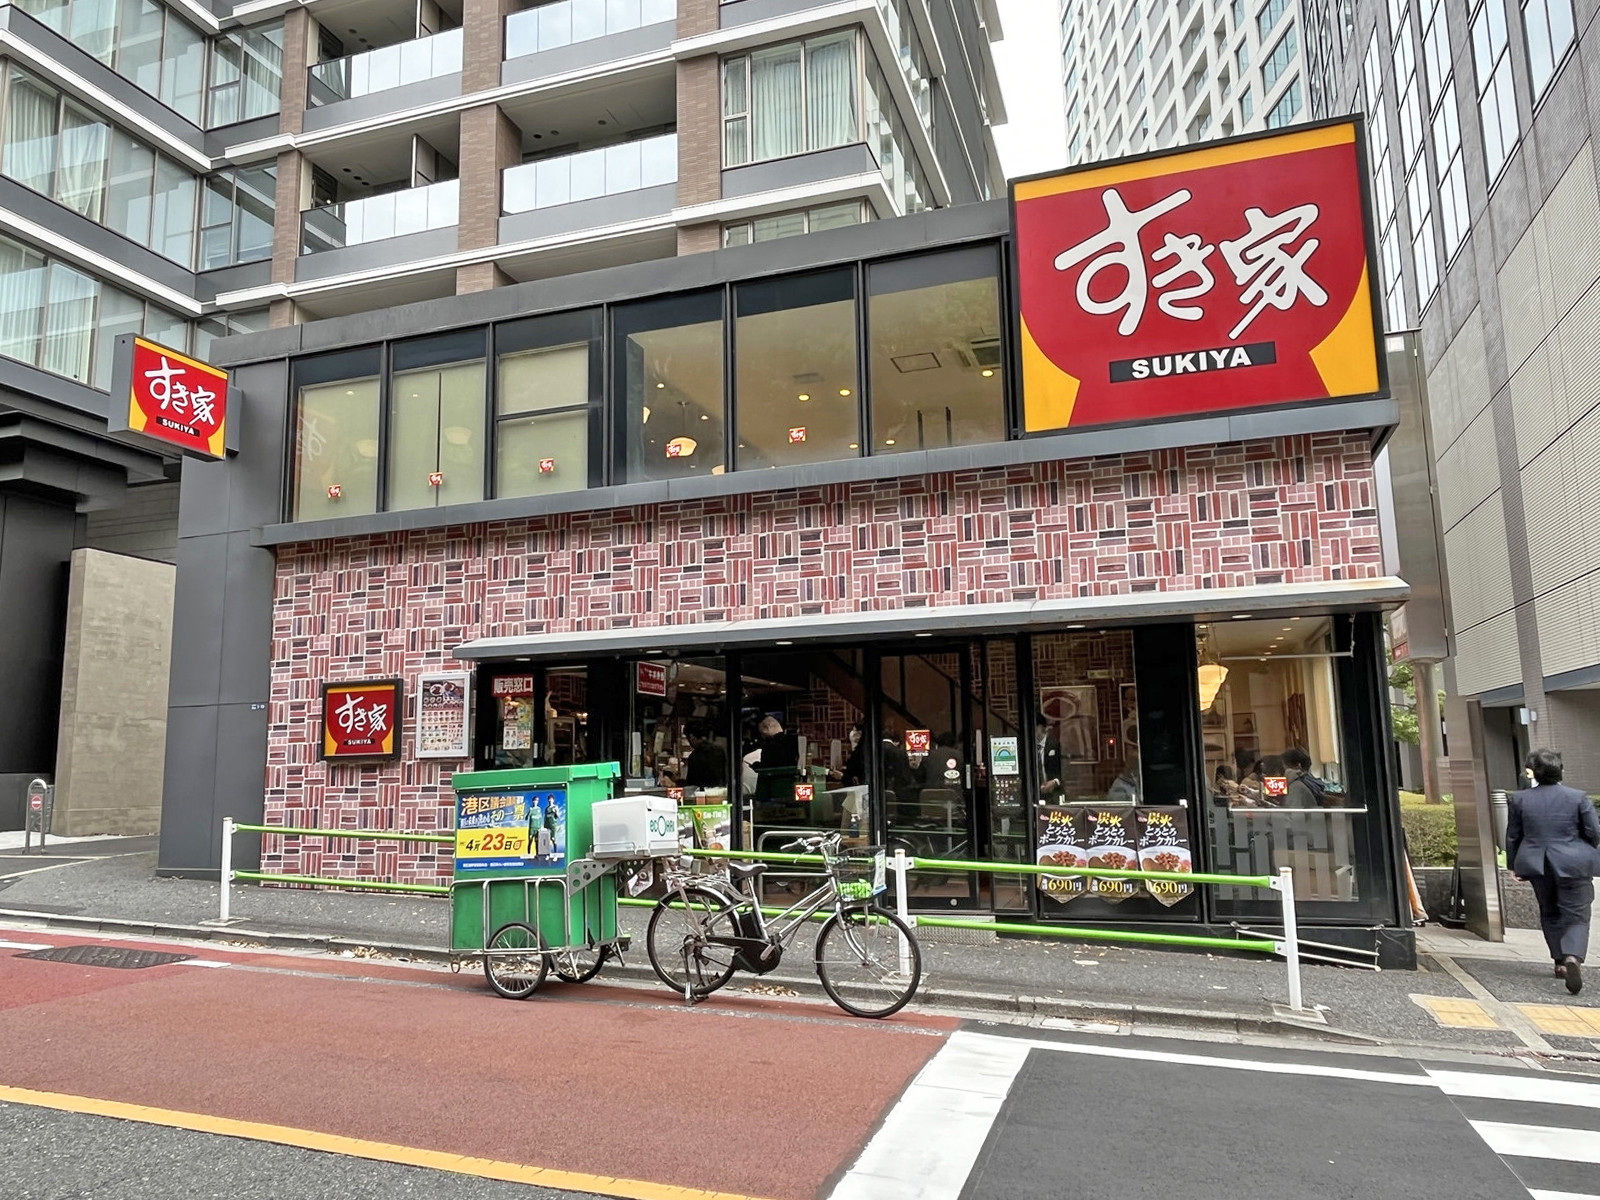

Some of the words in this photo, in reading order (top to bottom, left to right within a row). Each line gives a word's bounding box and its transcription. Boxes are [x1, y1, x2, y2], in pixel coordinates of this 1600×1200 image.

[1054, 188, 1329, 340] すき家
[1131, 346, 1252, 379] SUKIYA
[144, 356, 216, 426] すき家
[162, 418, 195, 435] SUKIYA
[494, 677, 533, 694] 販売窓口
[335, 693, 387, 737] すき家
[1046, 824, 1076, 836] とろとろ
[1094, 824, 1126, 836] とろとろ
[1145, 825, 1177, 836] とろとろ
